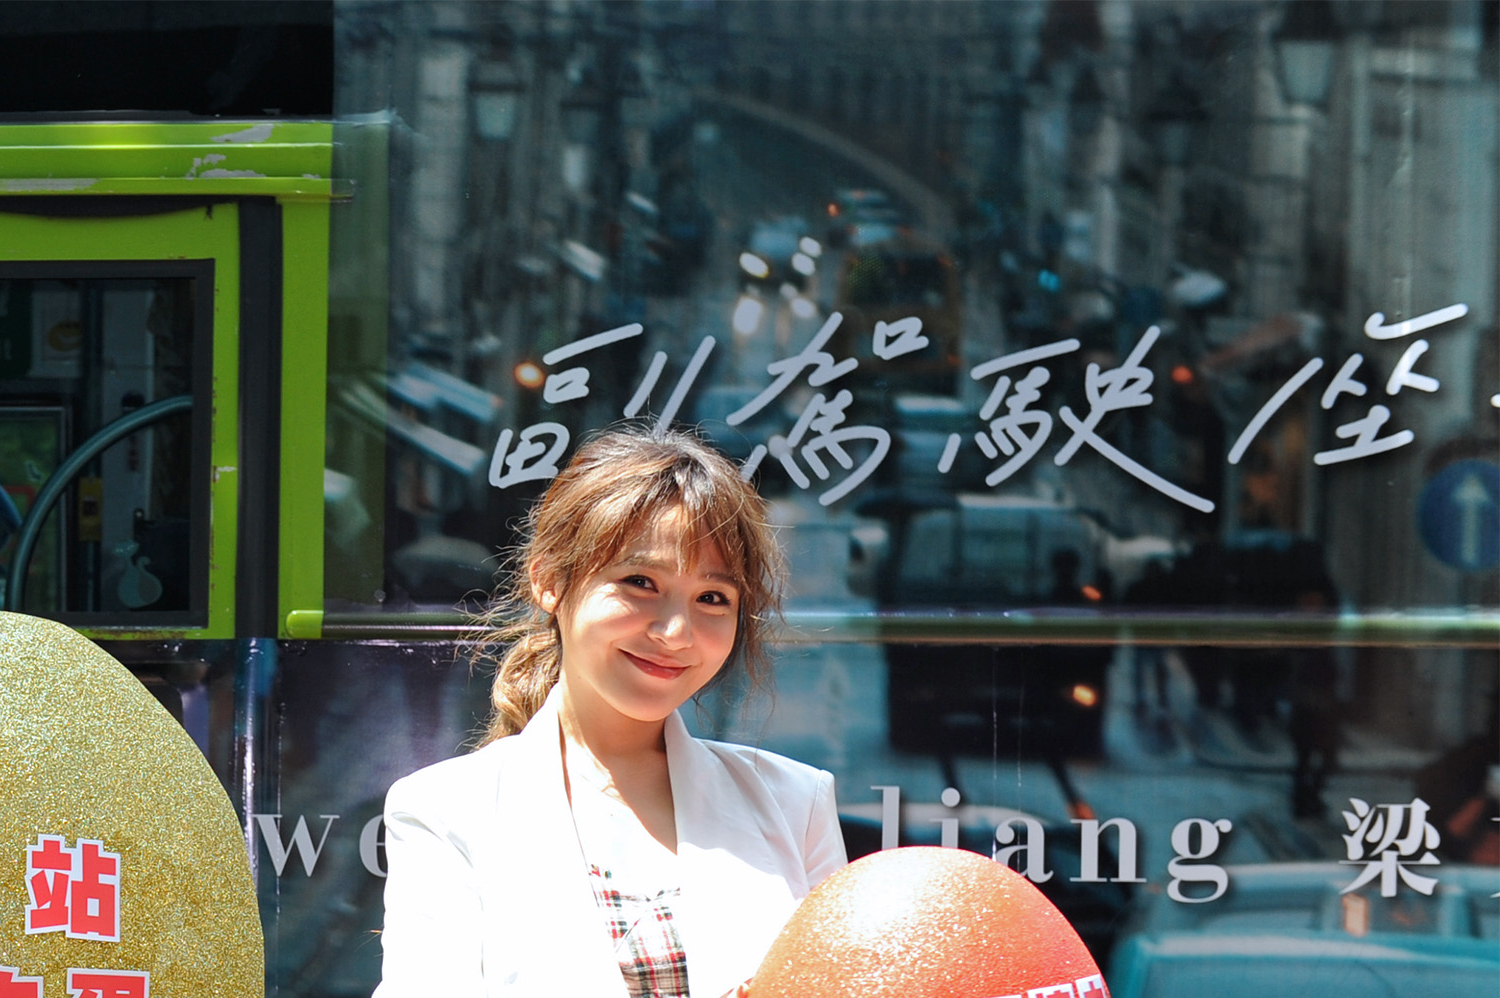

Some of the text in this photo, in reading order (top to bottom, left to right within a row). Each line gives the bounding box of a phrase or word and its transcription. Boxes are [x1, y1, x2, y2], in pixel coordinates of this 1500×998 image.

[488, 303, 1500, 514] 副駕駛座
[870, 785, 1233, 904] liang
[1339, 797, 1500, 899] 梁
